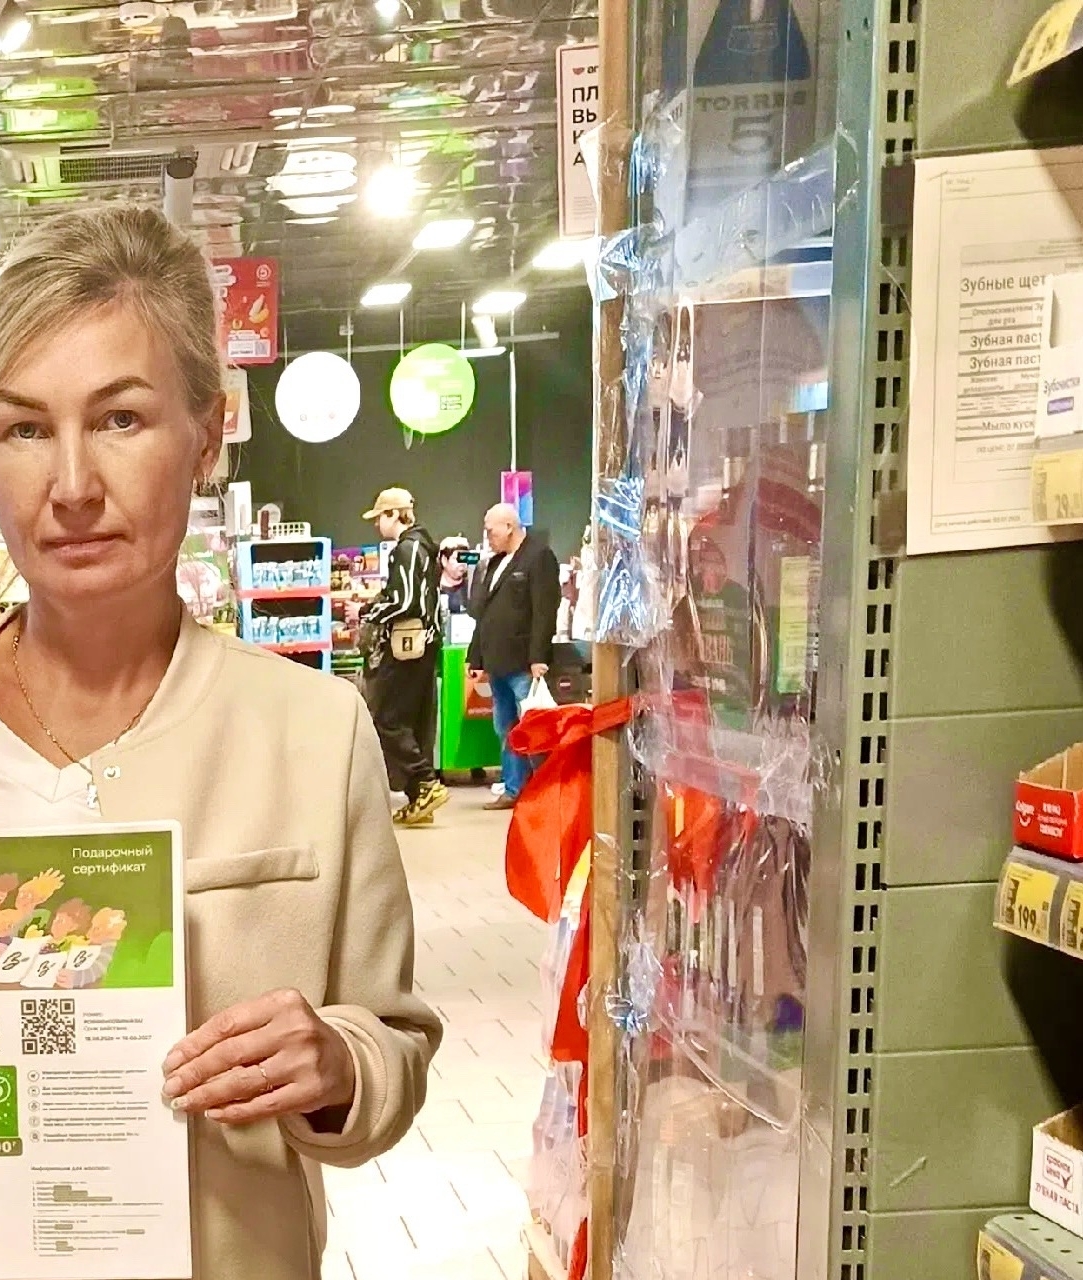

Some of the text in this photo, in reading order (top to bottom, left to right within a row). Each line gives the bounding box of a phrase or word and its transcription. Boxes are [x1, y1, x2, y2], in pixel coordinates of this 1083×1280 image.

[960, 275, 1046, 295] Зубные щет
[971, 333, 1013, 351] Зубная
[970, 356, 1012, 372] Зубная
[982, 421, 1011, 431] Мыло
[72, 844, 153, 861] Подарочный
[72, 861, 147, 876] сертификат
